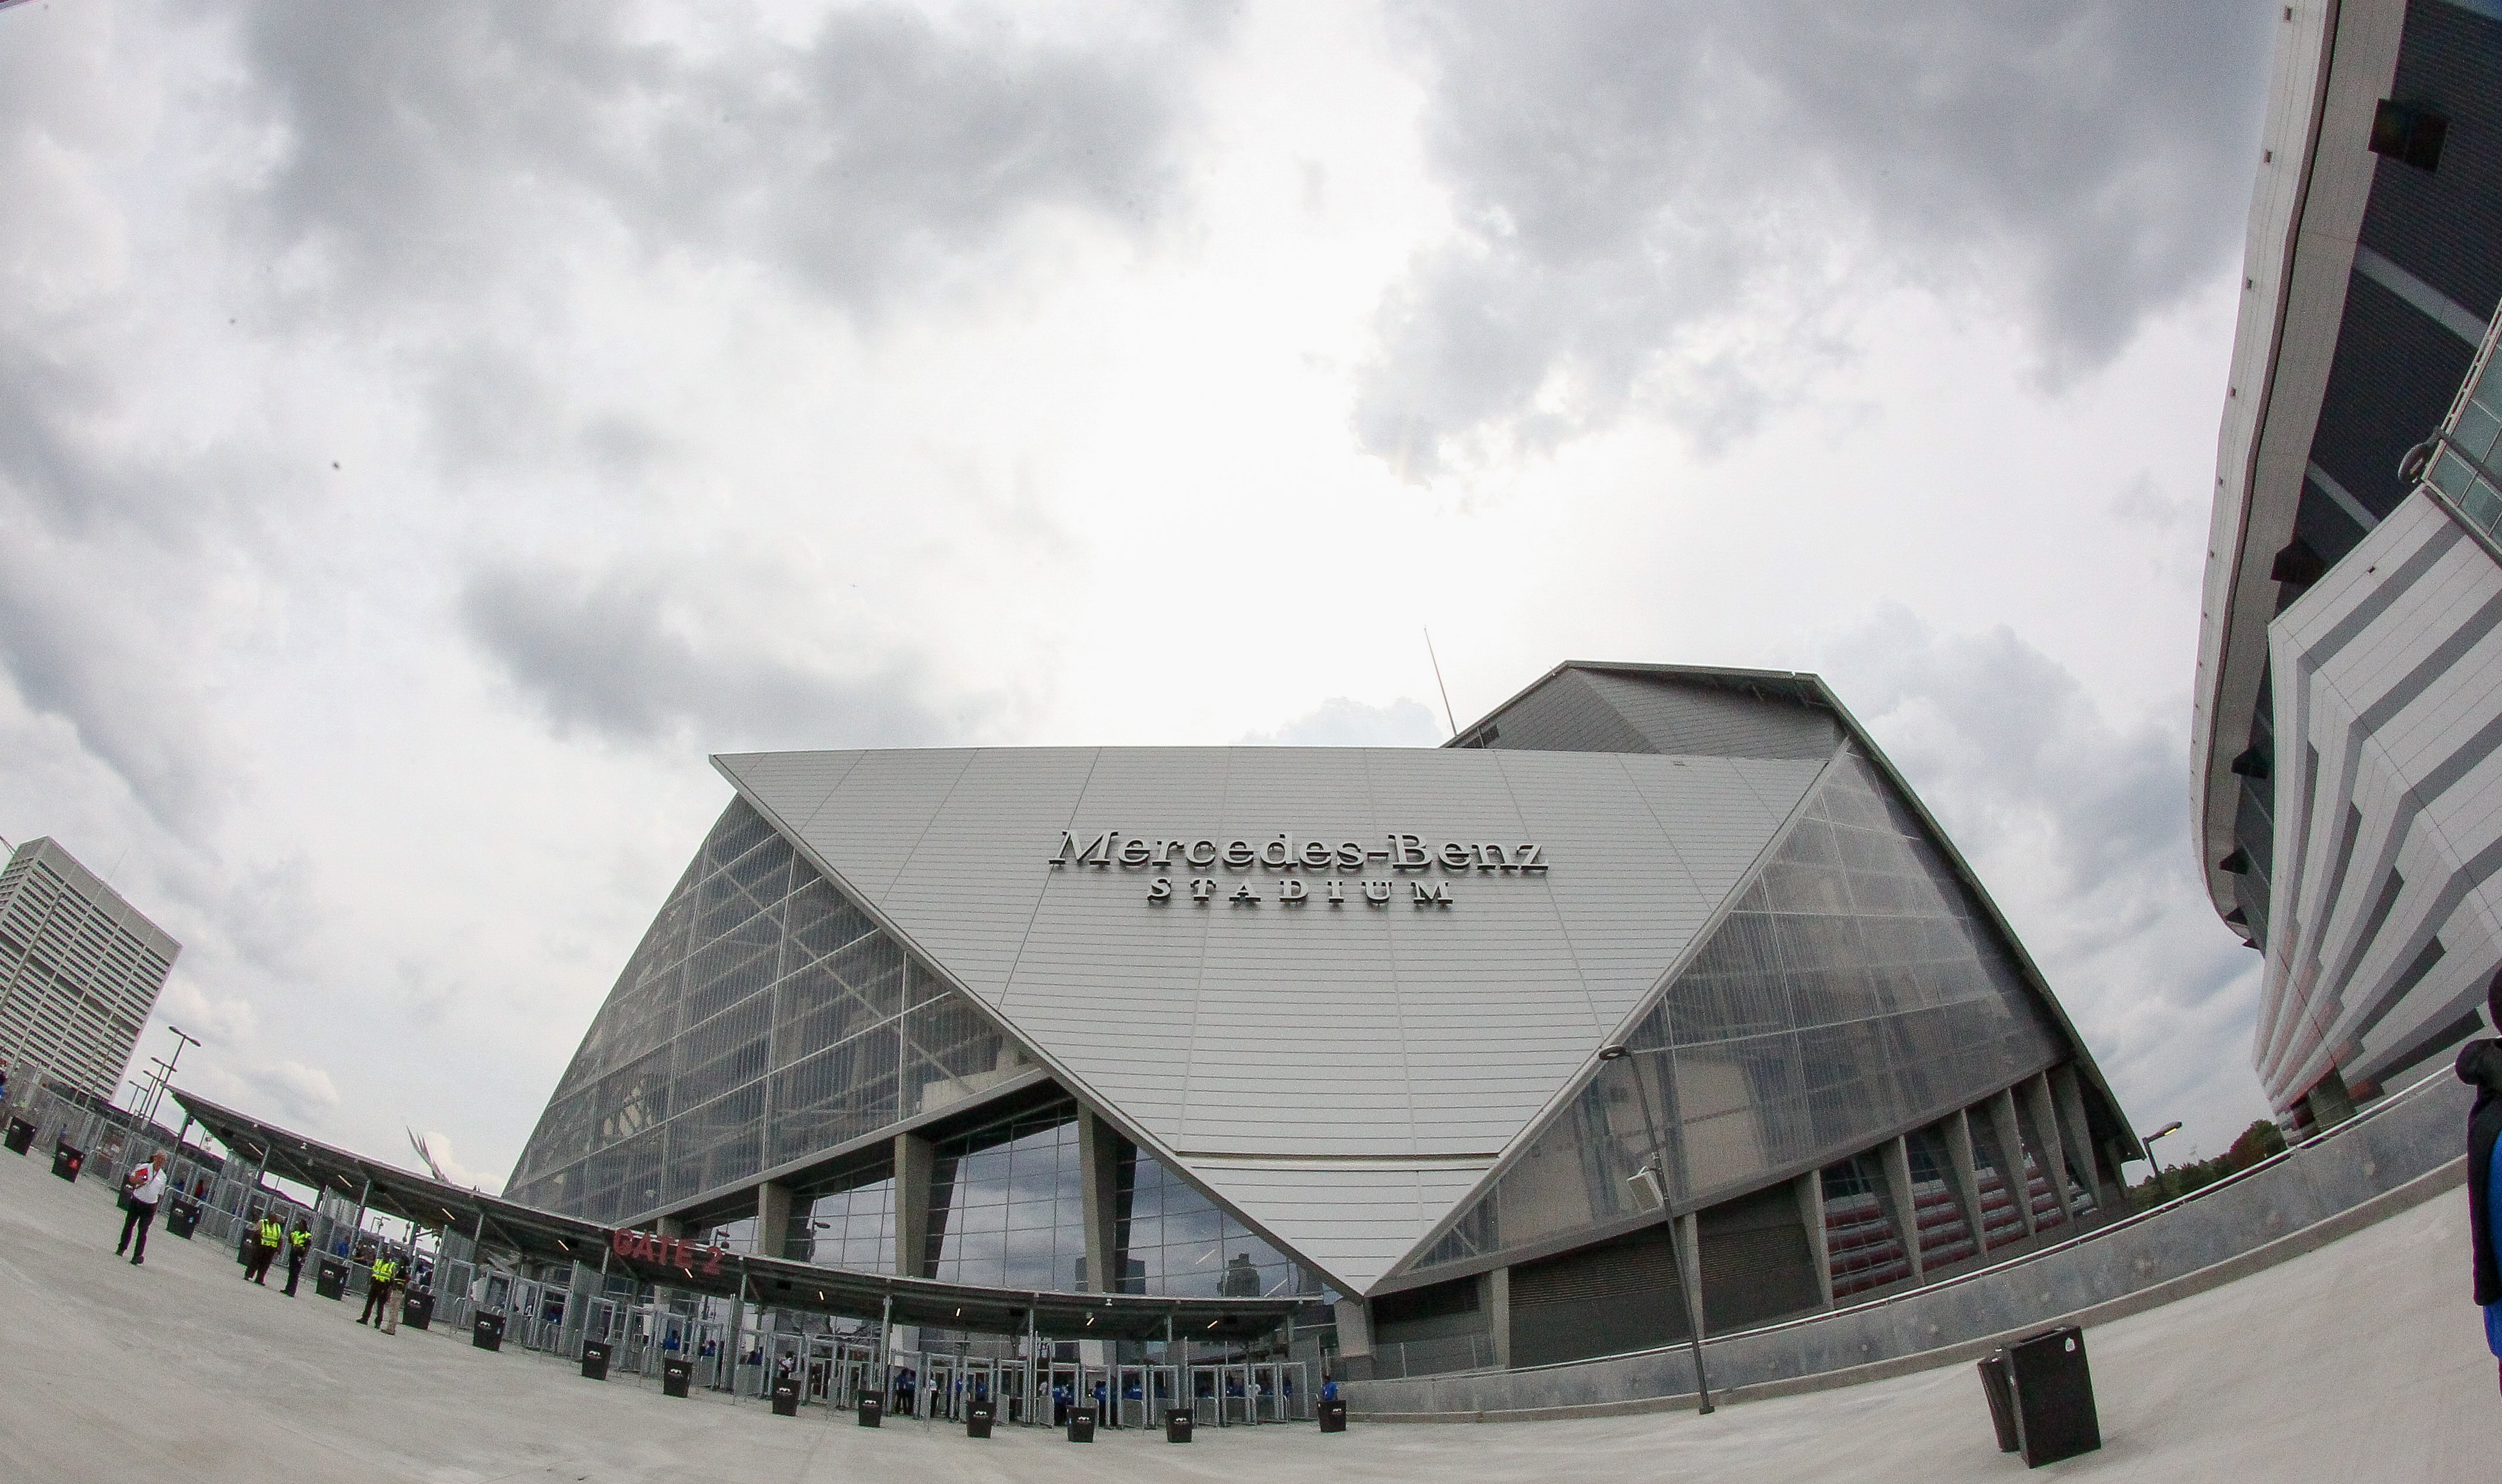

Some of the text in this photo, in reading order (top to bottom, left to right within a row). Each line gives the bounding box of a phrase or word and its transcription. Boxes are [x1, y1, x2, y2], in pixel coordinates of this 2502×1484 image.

[1048, 829, 1550, 872] Mercedes-Benz
[1146, 877, 1453, 904] STADIUM
[613, 1227, 723, 1275] GATE 2
